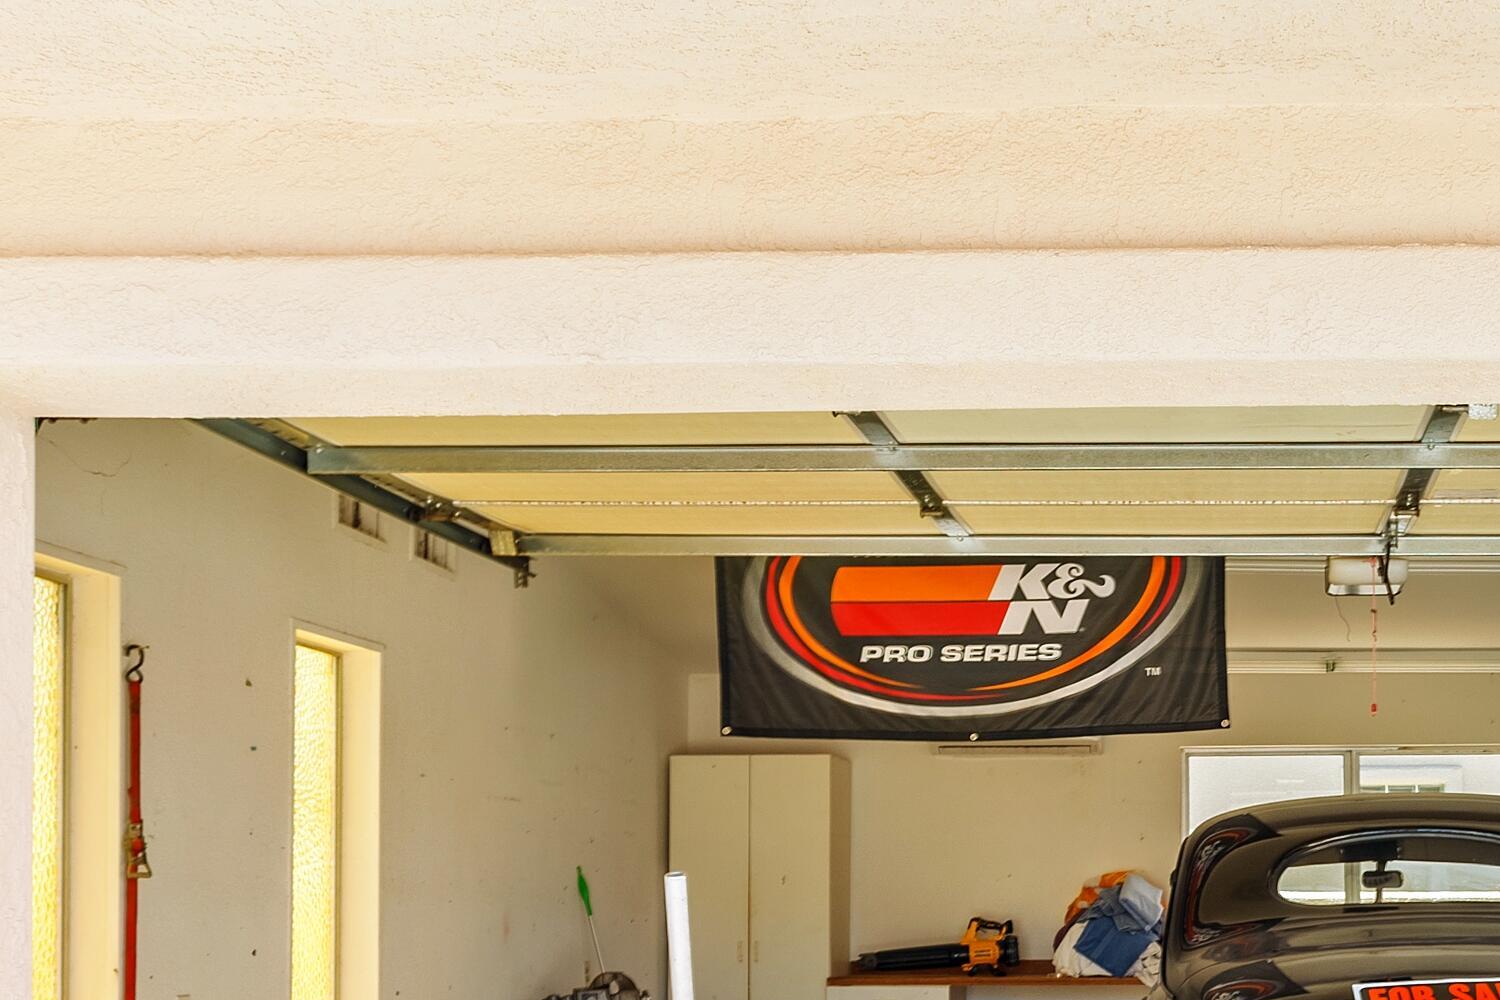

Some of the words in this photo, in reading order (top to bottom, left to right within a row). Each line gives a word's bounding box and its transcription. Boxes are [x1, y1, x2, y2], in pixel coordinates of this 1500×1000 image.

[860, 645, 933, 662] PRO
[940, 643, 1063, 662] SERIES
[1144, 666, 1161, 676] TM
